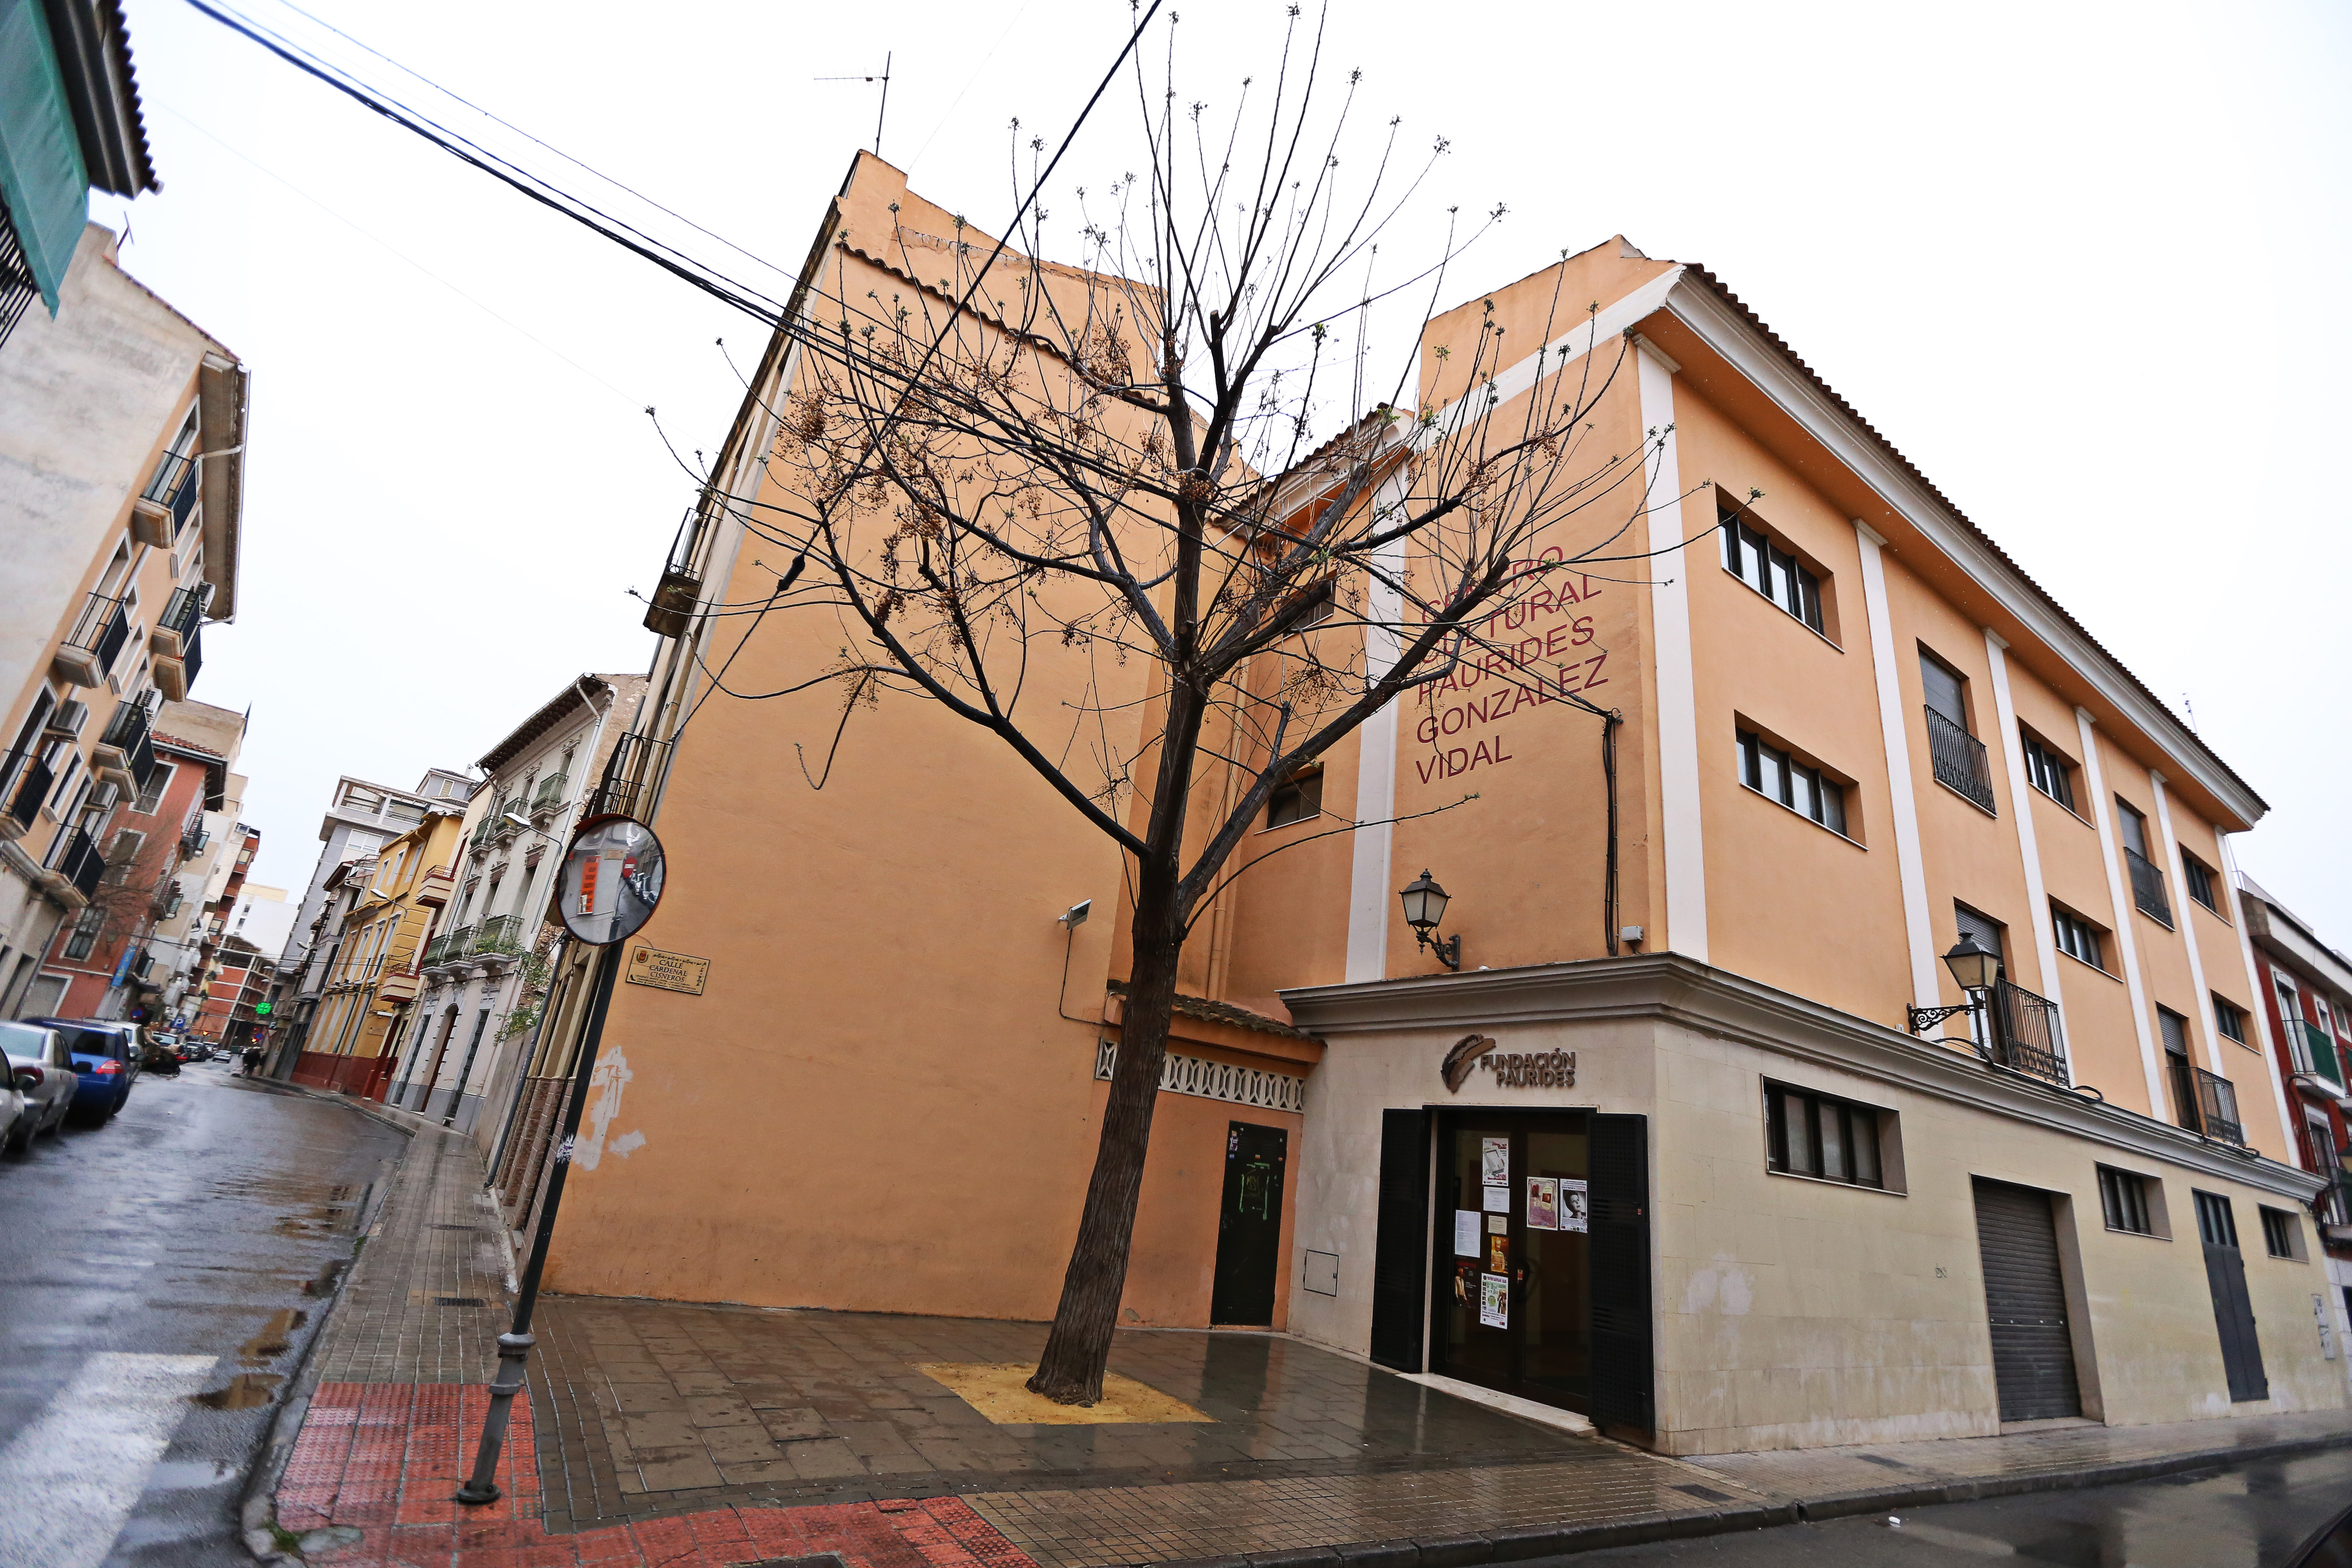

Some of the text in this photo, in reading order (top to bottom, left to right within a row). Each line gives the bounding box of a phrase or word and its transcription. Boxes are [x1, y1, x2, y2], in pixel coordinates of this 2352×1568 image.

[1418, 616, 1595, 705] PAURIDES
[1416, 653, 1609, 744] GONZALEZ
[1415, 735, 1513, 784] VIDAL
[649, 965, 687, 977] CARDENAL
[659, 959, 683, 969] CALLE
[650, 971, 685, 983] CISNEROS
[1480, 1047, 1576, 1071] FUNDACIÓN
[1496, 1069, 1575, 1087] PAURIDES
